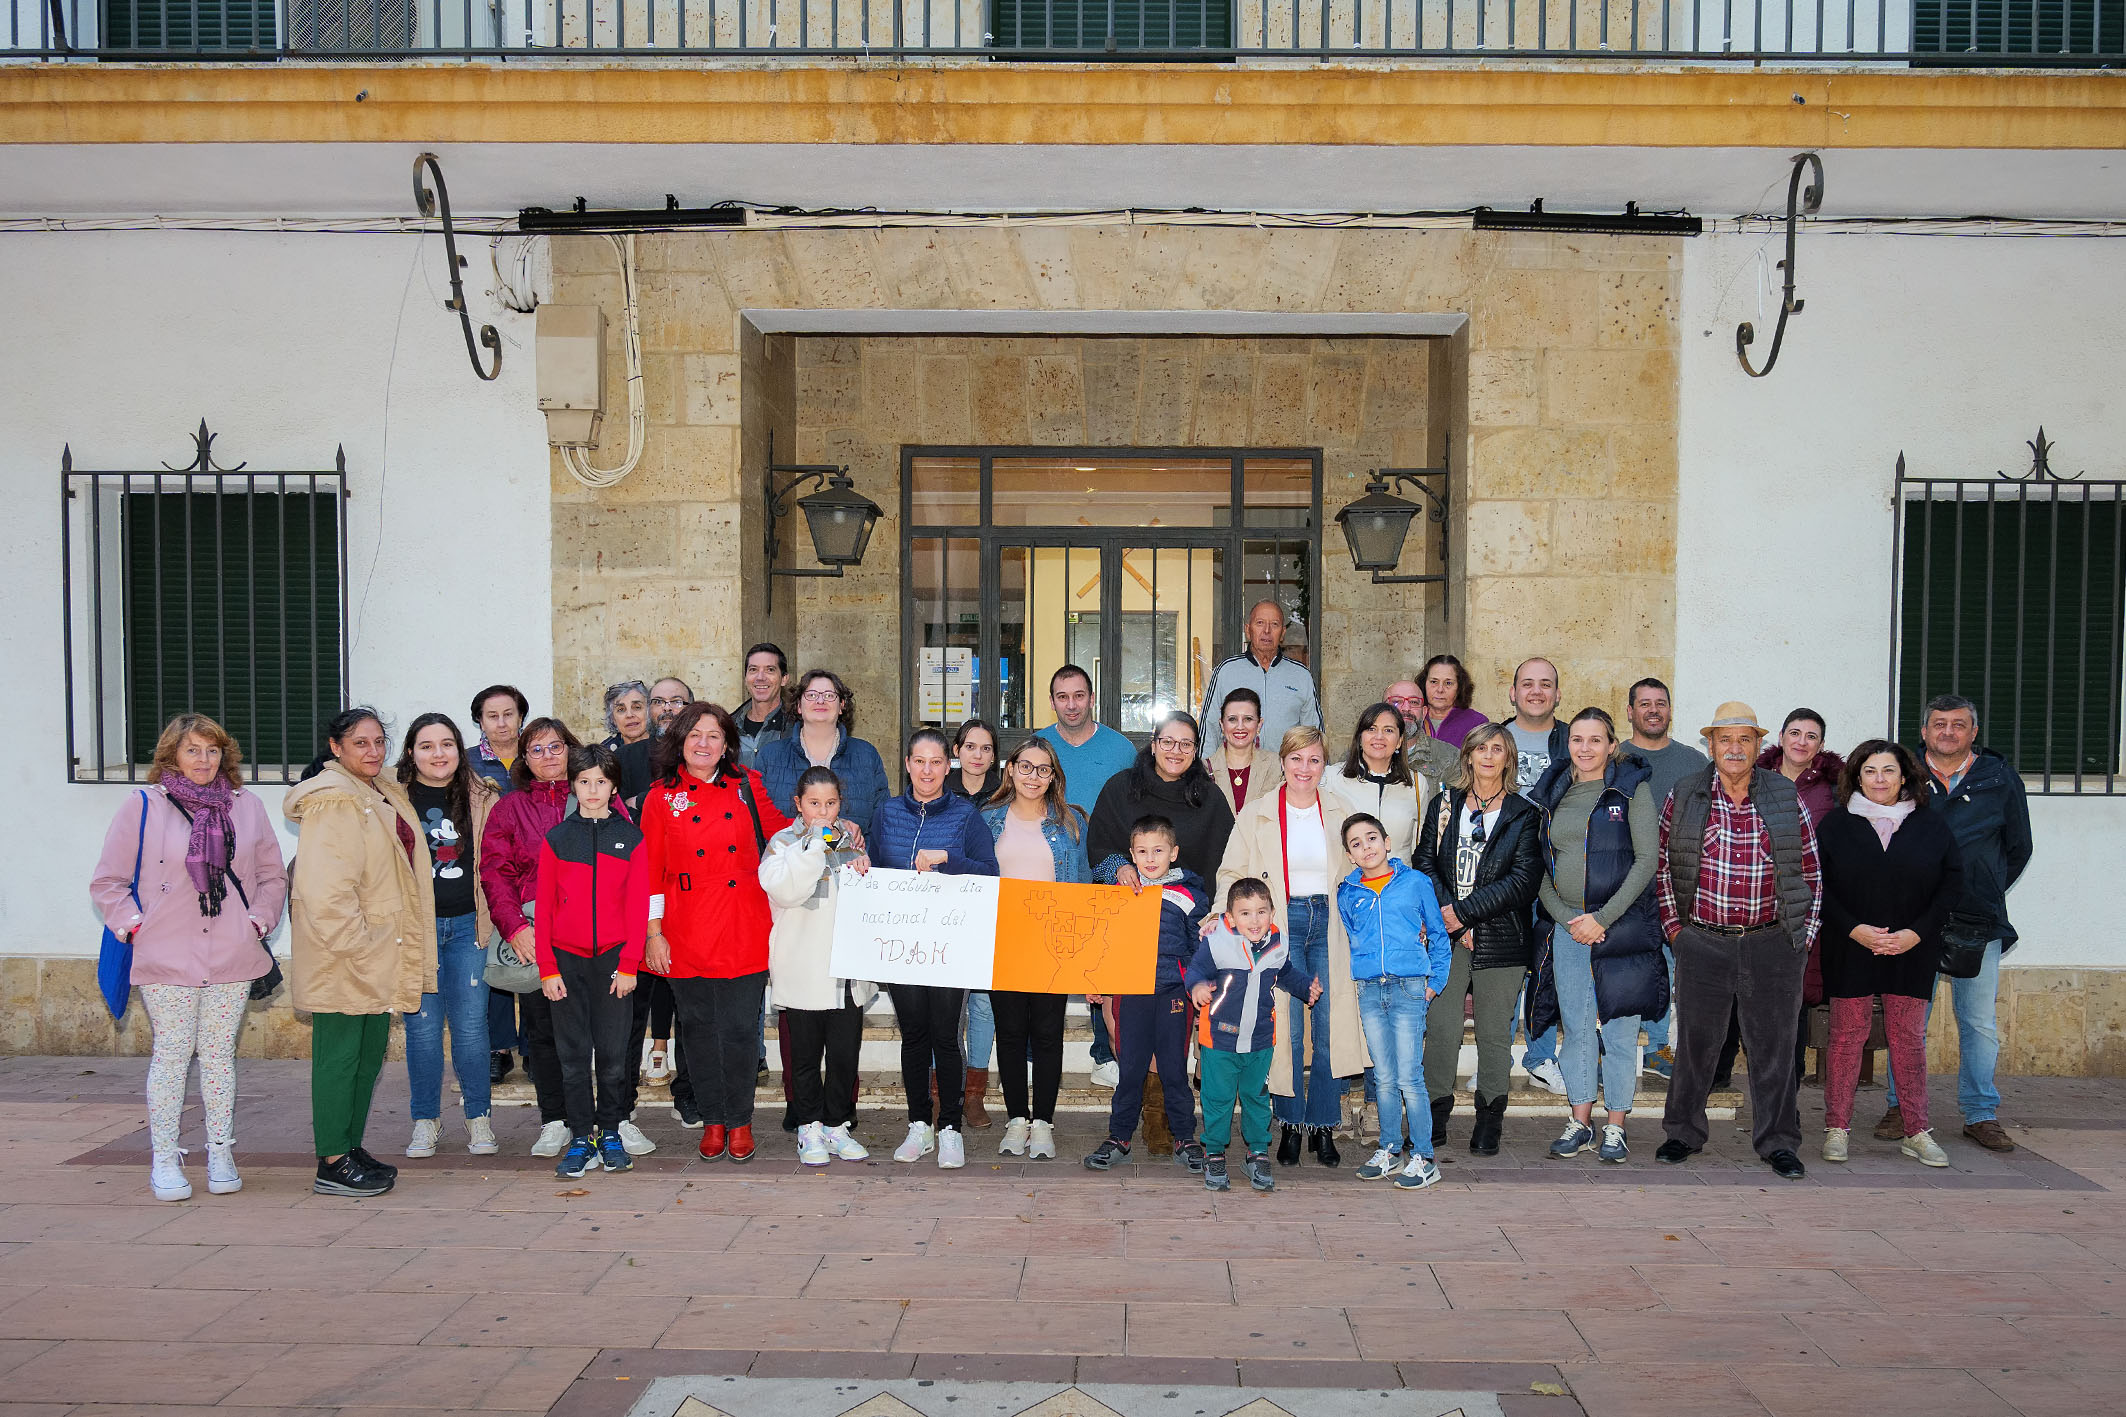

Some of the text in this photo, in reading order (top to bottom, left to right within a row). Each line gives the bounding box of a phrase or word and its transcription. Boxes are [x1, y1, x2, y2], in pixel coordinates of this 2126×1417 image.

[865, 875, 879, 890] de
[888, 876, 943, 893] octubre
[861, 908, 967, 926] nacional del
[873, 937, 949, 965] TDAH
